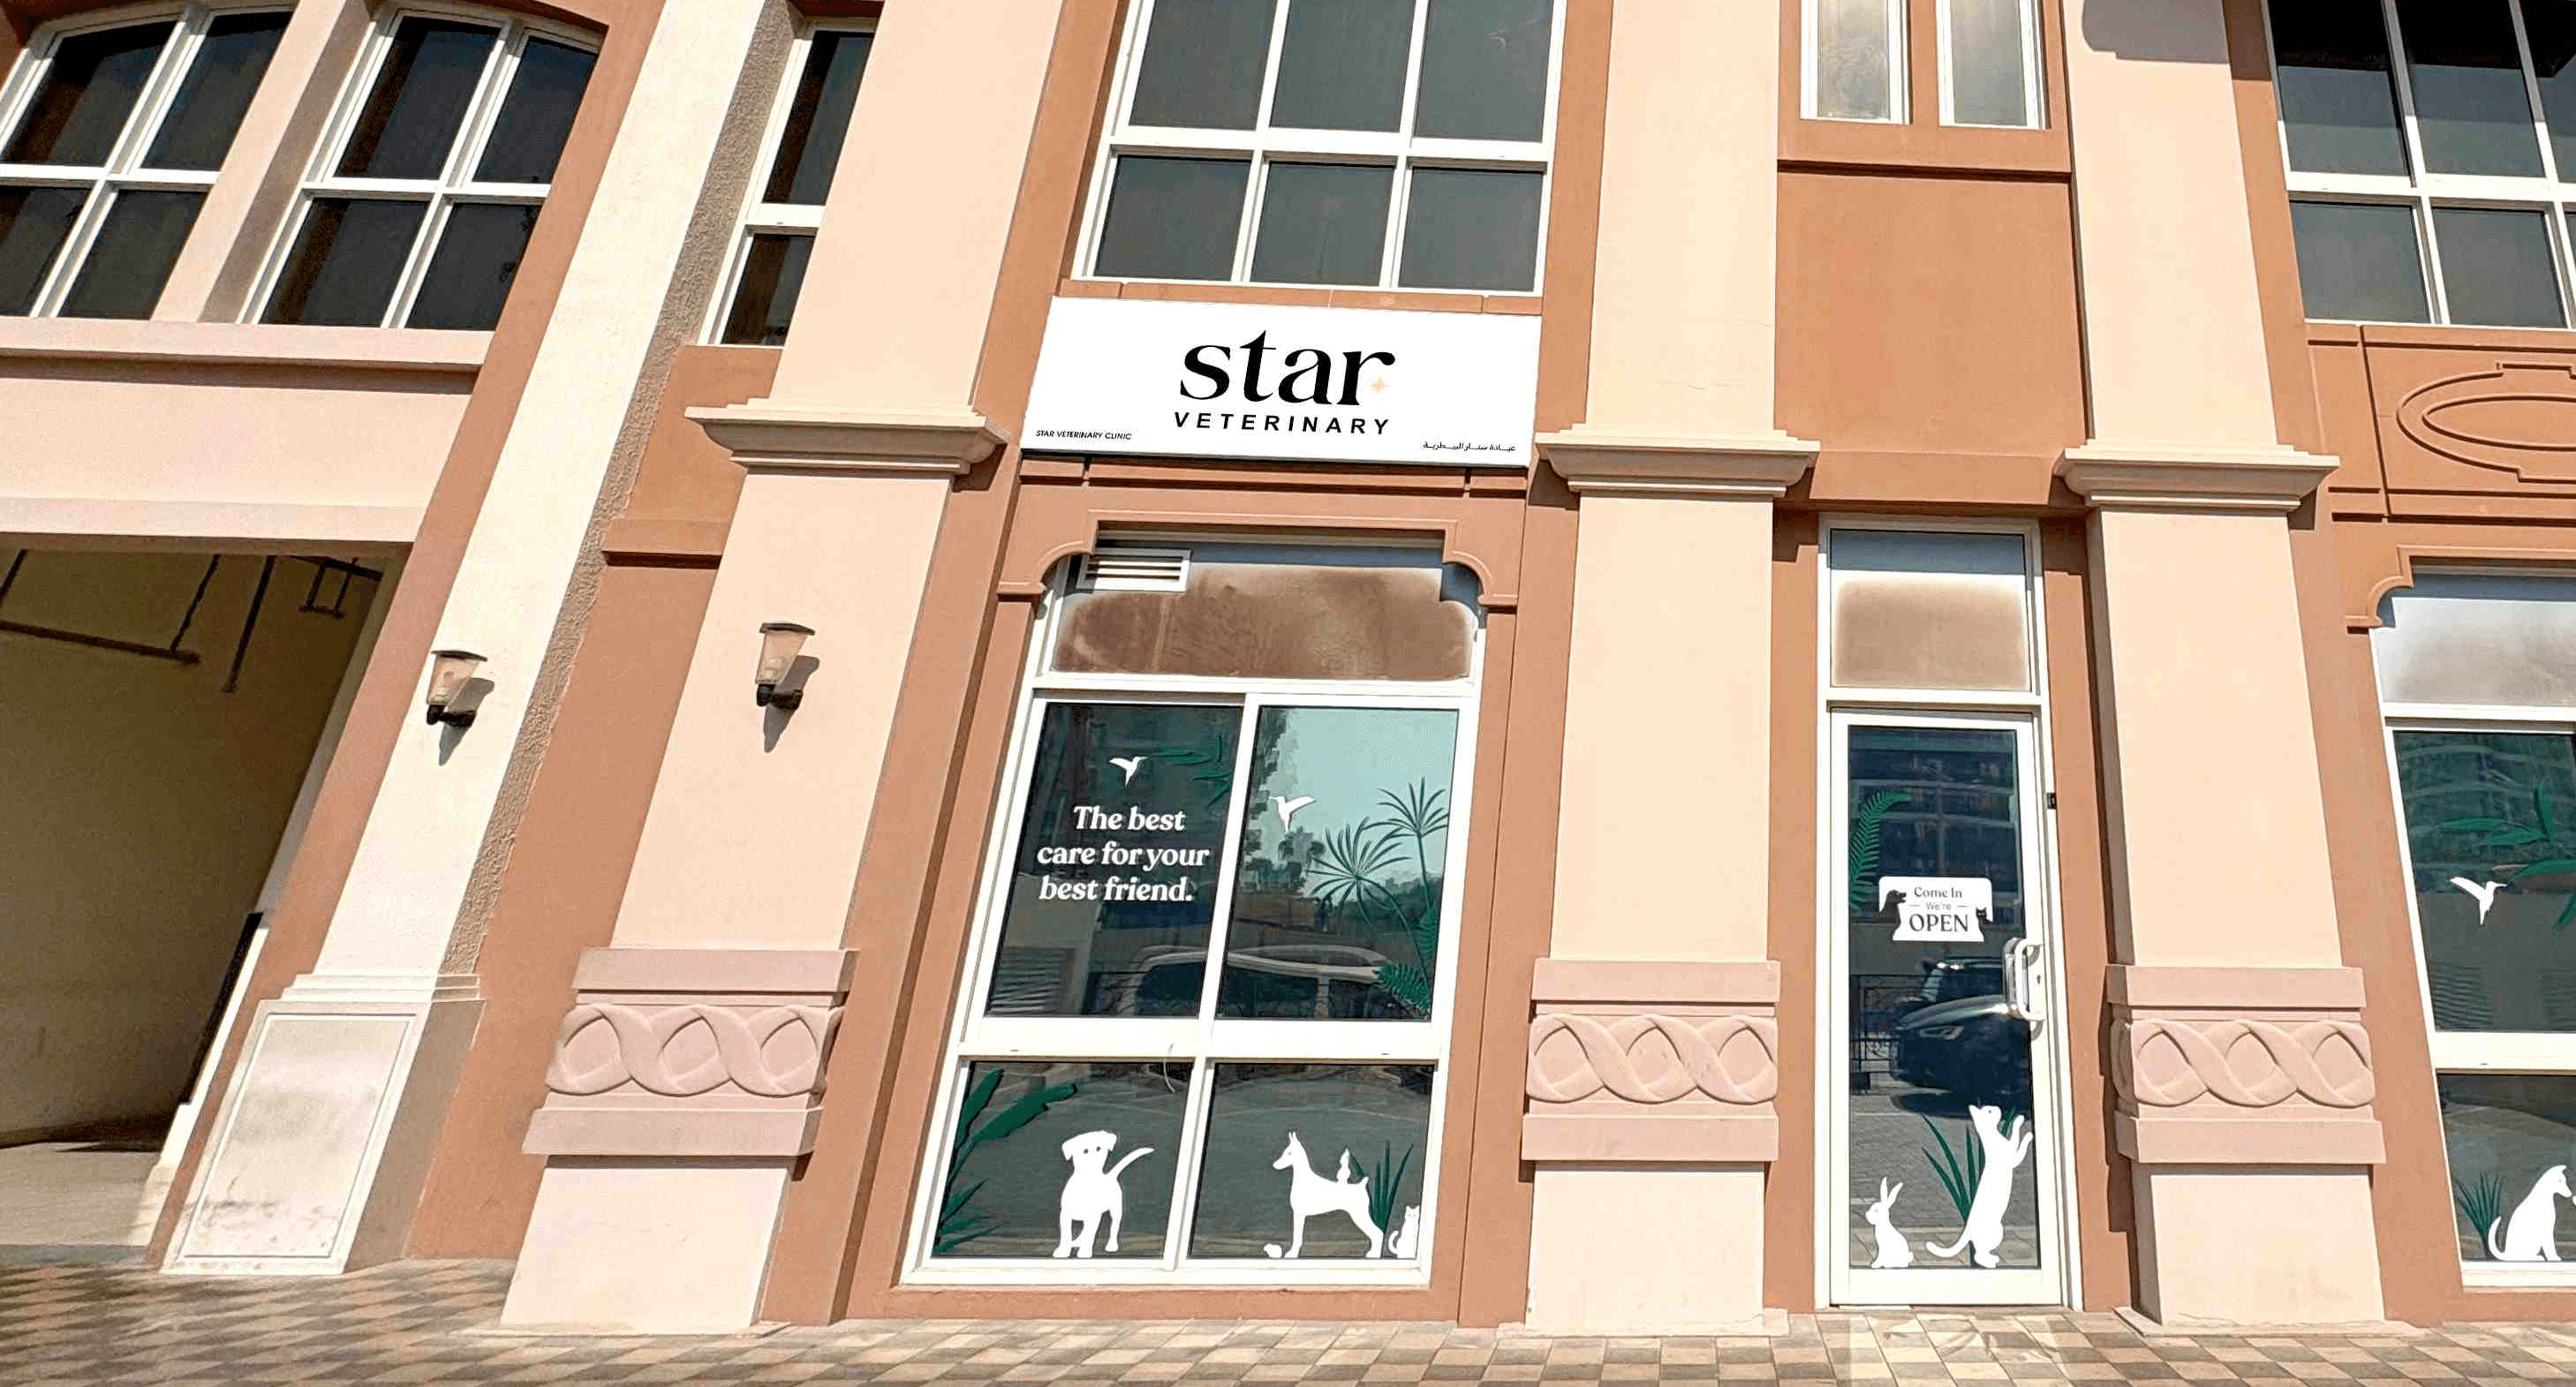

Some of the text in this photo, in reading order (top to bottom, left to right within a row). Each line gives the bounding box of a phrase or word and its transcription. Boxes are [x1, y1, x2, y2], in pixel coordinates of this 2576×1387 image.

[1180, 330, 1396, 406] star
[1174, 411, 1389, 435] VETERINARY
[1056, 430, 1104, 439] VETERINARY
[1104, 432, 1132, 441] CLINIC
[1073, 805, 1186, 831] The best
[1037, 840, 1211, 872] care for your
[1038, 874, 1193, 901] best friend.
[1914, 886, 1963, 899] Come In
[1926, 901, 1953, 911] We're
[1908, 914, 1969, 932] OPEN
